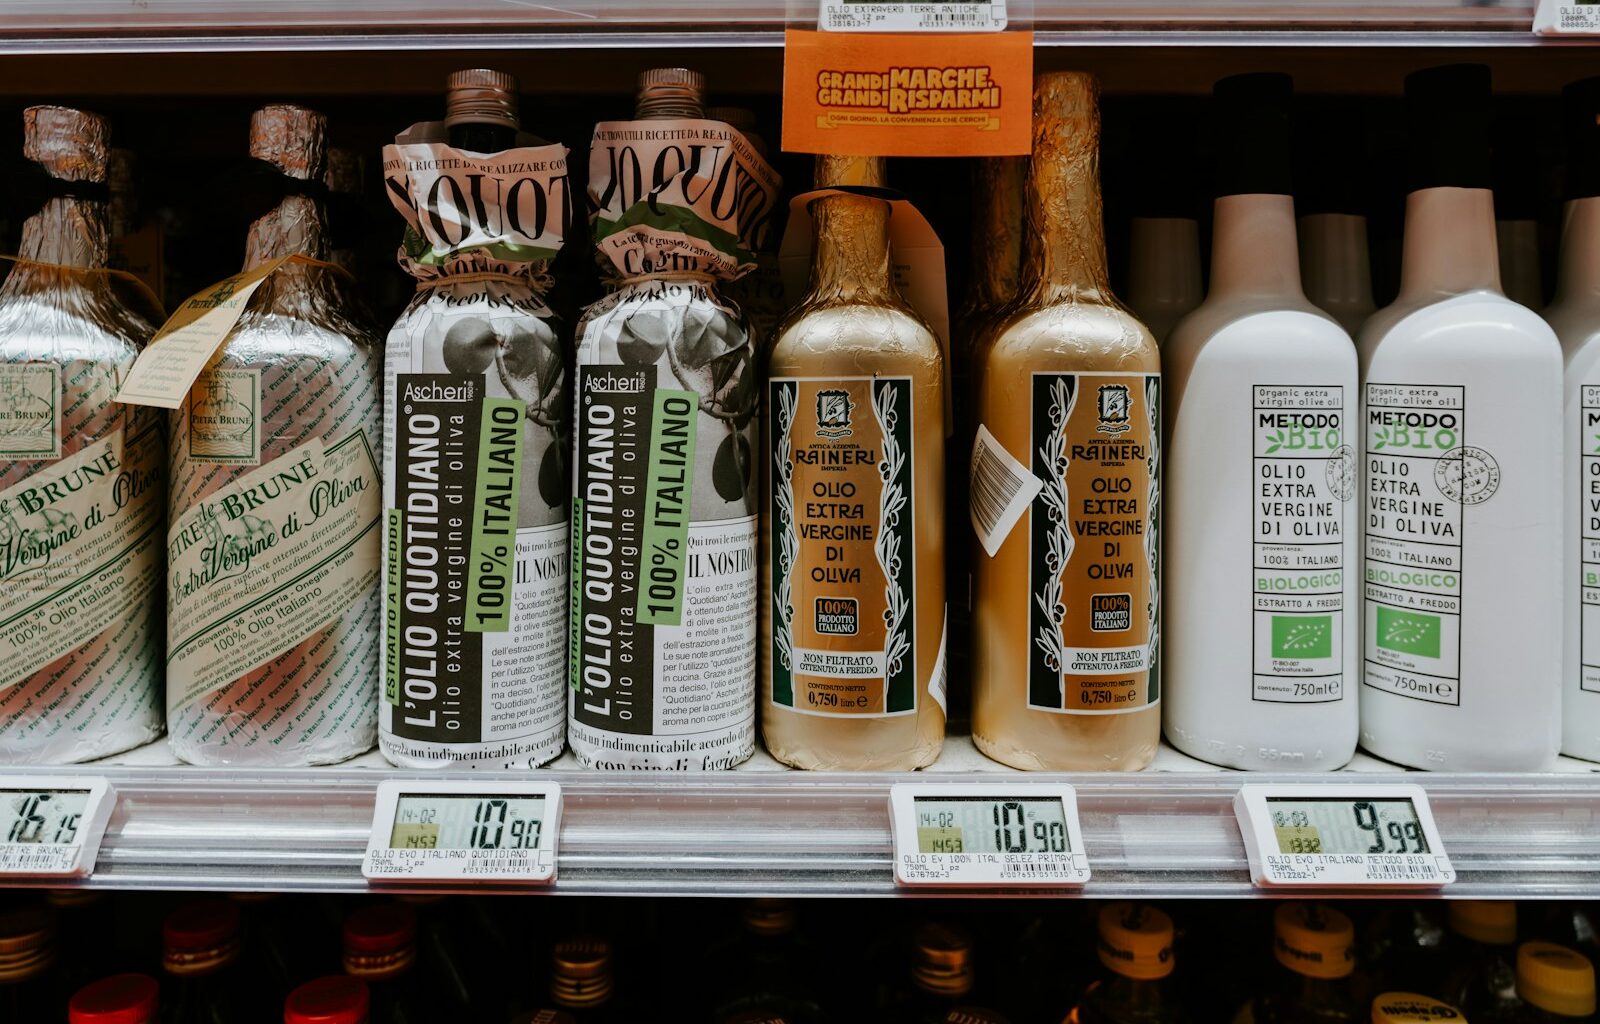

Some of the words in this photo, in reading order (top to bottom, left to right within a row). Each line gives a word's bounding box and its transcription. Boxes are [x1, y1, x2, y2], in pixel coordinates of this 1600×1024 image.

[827, 5, 853, 13] OLIO
[910, 5, 936, 13] TERRE
[941, 5, 980, 13] ANTICHE
[818, 72, 888, 89] GRANDI
[890, 67, 994, 88] MARCHE,
[818, 88, 888, 106] GRANDI
[889, 87, 1000, 112] RISPARMI
[645, 130, 687, 140] RICETTE
[687, 129, 699, 139] DA
[414, 158, 461, 171] RICETTE
[480, 161, 548, 175] REALIZZARE
[584, 371, 639, 393] Ascheri
[404, 380, 467, 402] Ascheri
[1259, 389, 1299, 398] Organic
[1260, 397, 1294, 407] virgin
[1299, 398, 1324, 406] olive
[220, 414, 251, 425] BRUNE
[1259, 414, 1339, 428] METODO
[1370, 411, 1457, 429] METODO
[619, 406, 636, 462] oliva
[445, 414, 464, 471] oliva
[796, 450, 875, 465] RAINERI
[1071, 445, 1145, 460] RAINERI
[482, 406, 519, 535] ITALIANO
[654, 398, 692, 528] ITALIANO
[1371, 460, 1409, 477] OLIO
[1261, 465, 1305, 479] OLIO
[16, 450, 121, 516] BRUNE
[221, 457, 318, 521] BRUNE
[619, 476, 636, 495] di
[813, 482, 856, 498] OLIO
[1091, 477, 1132, 493] OLIO
[1262, 484, 1316, 498] EXTRA
[1371, 478, 1420, 496] EXTRA
[444, 484, 463, 504] di
[281, 512, 303, 540] di
[304, 475, 369, 527] Oliva
[585, 404, 615, 602] QUOTIDIANO
[806, 503, 864, 519] EXTRA
[1084, 499, 1137, 515] EXTRA
[1262, 502, 1333, 517] VERGINE
[1370, 496, 1444, 517] VERGINE
[84, 503, 106, 531] di
[405, 414, 441, 614] QUOTIDIANO
[800, 524, 873, 540] VERGINE
[1075, 519, 1142, 536] VERGINE
[1262, 521, 1280, 535] DI
[1294, 521, 1339, 536] OLIVA
[1370, 514, 1385, 529] DI
[1396, 518, 1454, 537] OLIVA
[234, 560, 270, 586] superiore
[272, 539, 309, 566] ottenuto
[311, 507, 358, 542] direttamente
[389, 514, 398, 585] FREDDO
[617, 508, 638, 593] vergine
[826, 546, 843, 561] DI
[1104, 542, 1120, 558] DI
[445, 517, 466, 604] vergine
[687, 553, 705, 579] IL
[1263, 555, 1289, 565] 100%
[1296, 555, 1339, 565] ITALIANO
[1399, 552, 1452, 566] ITALIANO
[233, 575, 270, 601] mediante
[271, 543, 323, 584] procedimenti
[295, 570, 330, 592] Oneglia
[334, 550, 354, 568] Italia
[647, 538, 680, 617] 100%
[811, 567, 861, 583] OLIVA
[1087, 563, 1134, 580] OLIVA
[1366, 568, 1457, 588] BIOLOGICO
[475, 545, 508, 625] 100%
[715, 583, 733, 592] extra
[1257, 572, 1341, 590] BIOLOGICO
[389, 592, 396, 603] A
[1258, 599, 1302, 608] ESTRATTO
[1316, 598, 1341, 607] FREDDO
[8, 622, 48, 649] 100%
[49, 606, 77, 626] Olio
[78, 575, 125, 609] Italiano
[694, 606, 724, 616] ottenuto
[818, 601, 855, 615] 100%
[212, 629, 247, 654] 100%
[248, 616, 275, 634] Olio
[276, 586, 322, 618] Italiano
[696, 617, 715, 627] olive
[818, 614, 855, 624] PRODOTTO
[617, 606, 634, 663] extra
[696, 628, 718, 638] molite
[818, 623, 855, 633] ITALIANO
[444, 615, 461, 673] extra
[387, 610, 397, 699] ESTRATTO
[803, 653, 823, 663] NON
[825, 655, 874, 665] FILTRATO
[1076, 652, 1099, 662] NON
[1101, 650, 1141, 661] FILTRATO
[800, 663, 838, 674] OTTENUTO
[846, 666, 878, 674] FREDDO
[616, 677, 633, 720] olio
[808, 692, 838, 707] 0,750
[1081, 691, 1112, 705] 0,750
[442, 686, 461, 730] olio
[601, 734, 697, 753] indimenticabile
[699, 732, 737, 749] accordo
[401, 809, 437, 824] 14-02
[920, 812, 954, 827] 14-02
[406, 835, 437, 848] 1453
[932, 839, 962, 853] 1453
[371, 850, 394, 858] OLIO
[423, 850, 467, 858] ITALIANO
[472, 850, 528, 858] QUOTIDIANO
[904, 855, 926, 863] OLIO
[950, 855, 971, 863] 100%
[978, 855, 999, 863] ITAL
[1005, 855, 1033, 863] SELEZ
[1267, 855, 1291, 864] OLIO
[1319, 855, 1364, 864] ITALIANO
[1368, 856, 1403, 864] METODO
[1407, 856, 1425, 864] BIO
